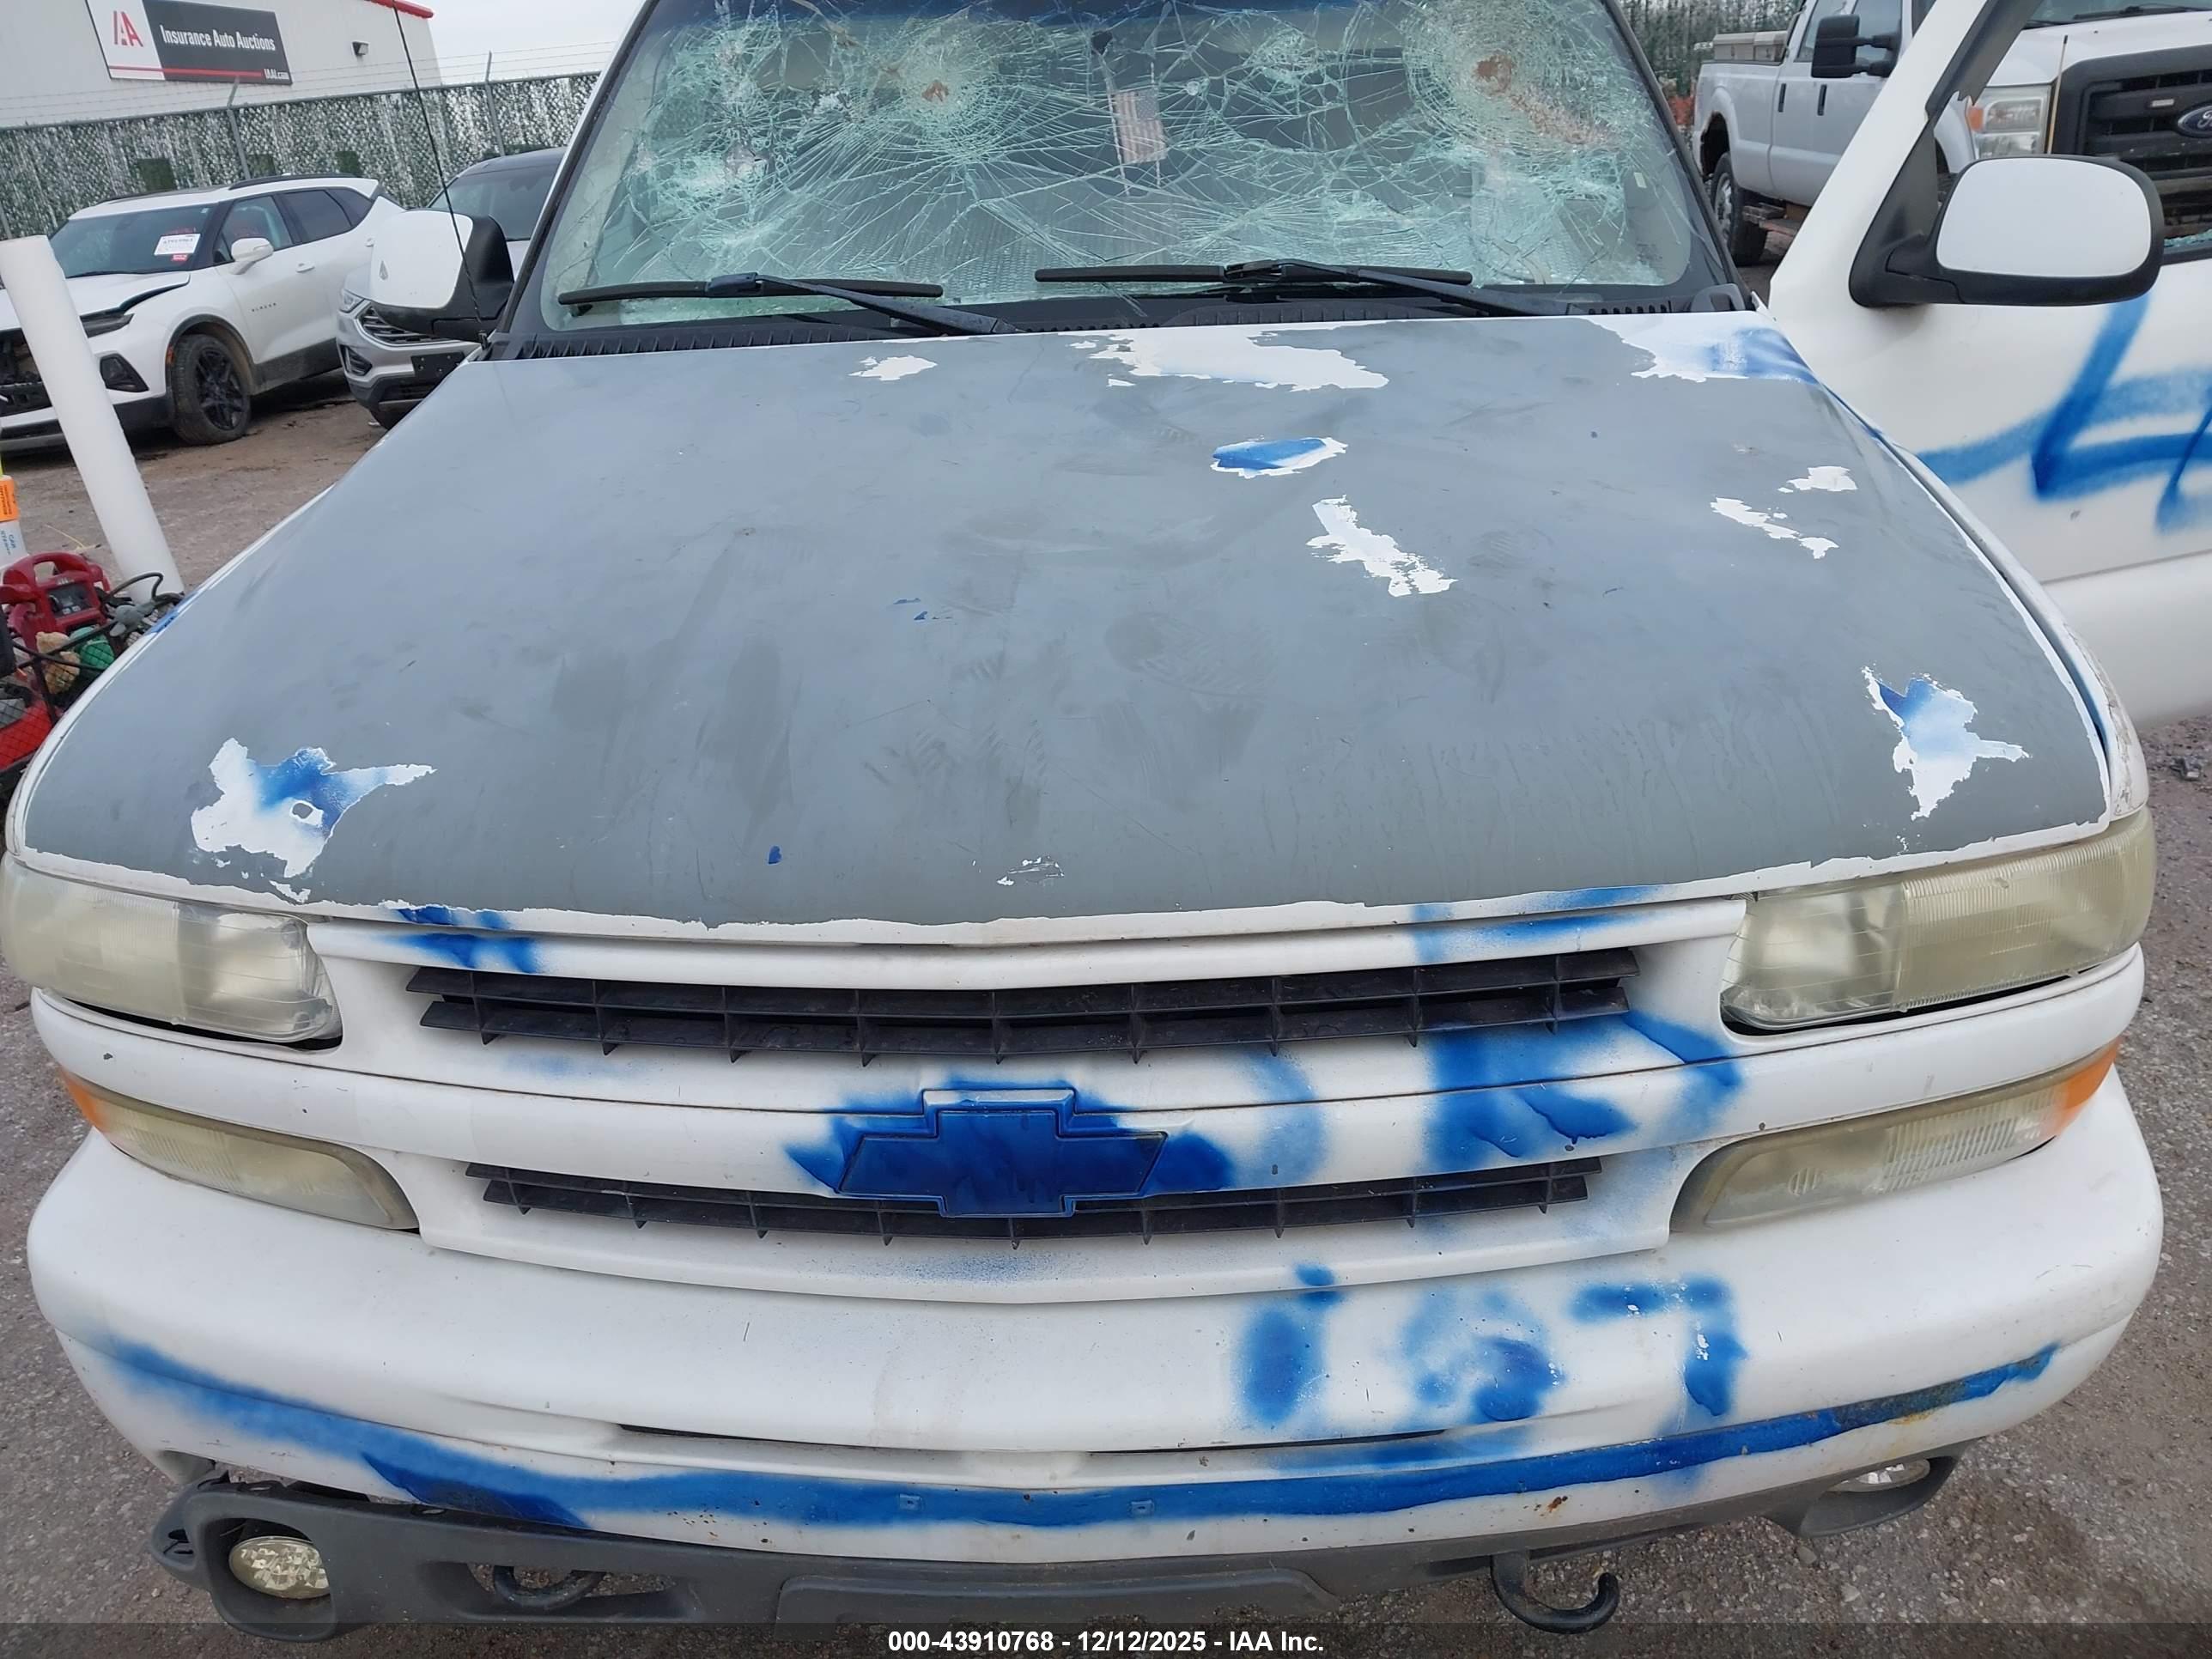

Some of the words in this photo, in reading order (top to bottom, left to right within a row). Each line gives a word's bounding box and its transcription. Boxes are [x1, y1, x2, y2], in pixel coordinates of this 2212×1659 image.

[159, 24, 213, 46] Insurance
[212, 29, 236, 48] Auto
[235, 31, 276, 51] Auctions
